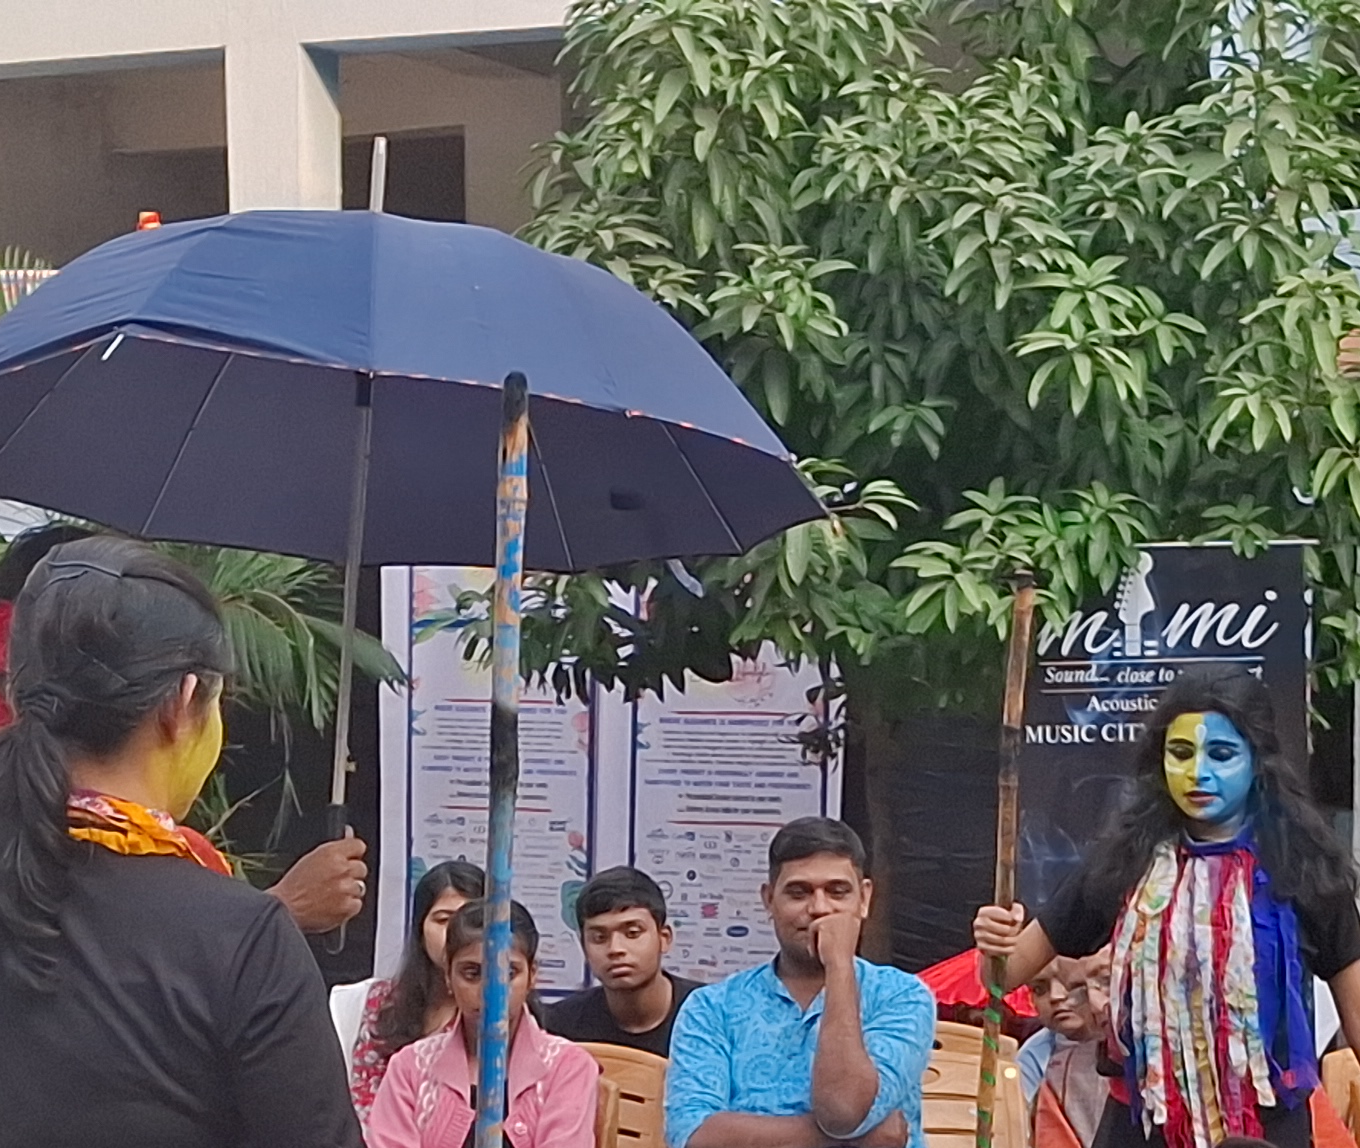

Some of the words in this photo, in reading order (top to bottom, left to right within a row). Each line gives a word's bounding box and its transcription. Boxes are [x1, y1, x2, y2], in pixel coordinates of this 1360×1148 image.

[1117, 667, 1157, 683] close
[1158, 668, 1175, 683] to
[1087, 696, 1159, 713] Acoustic
[1025, 724, 1097, 744] MUSIC
[1101, 722, 1147, 743] CIT
